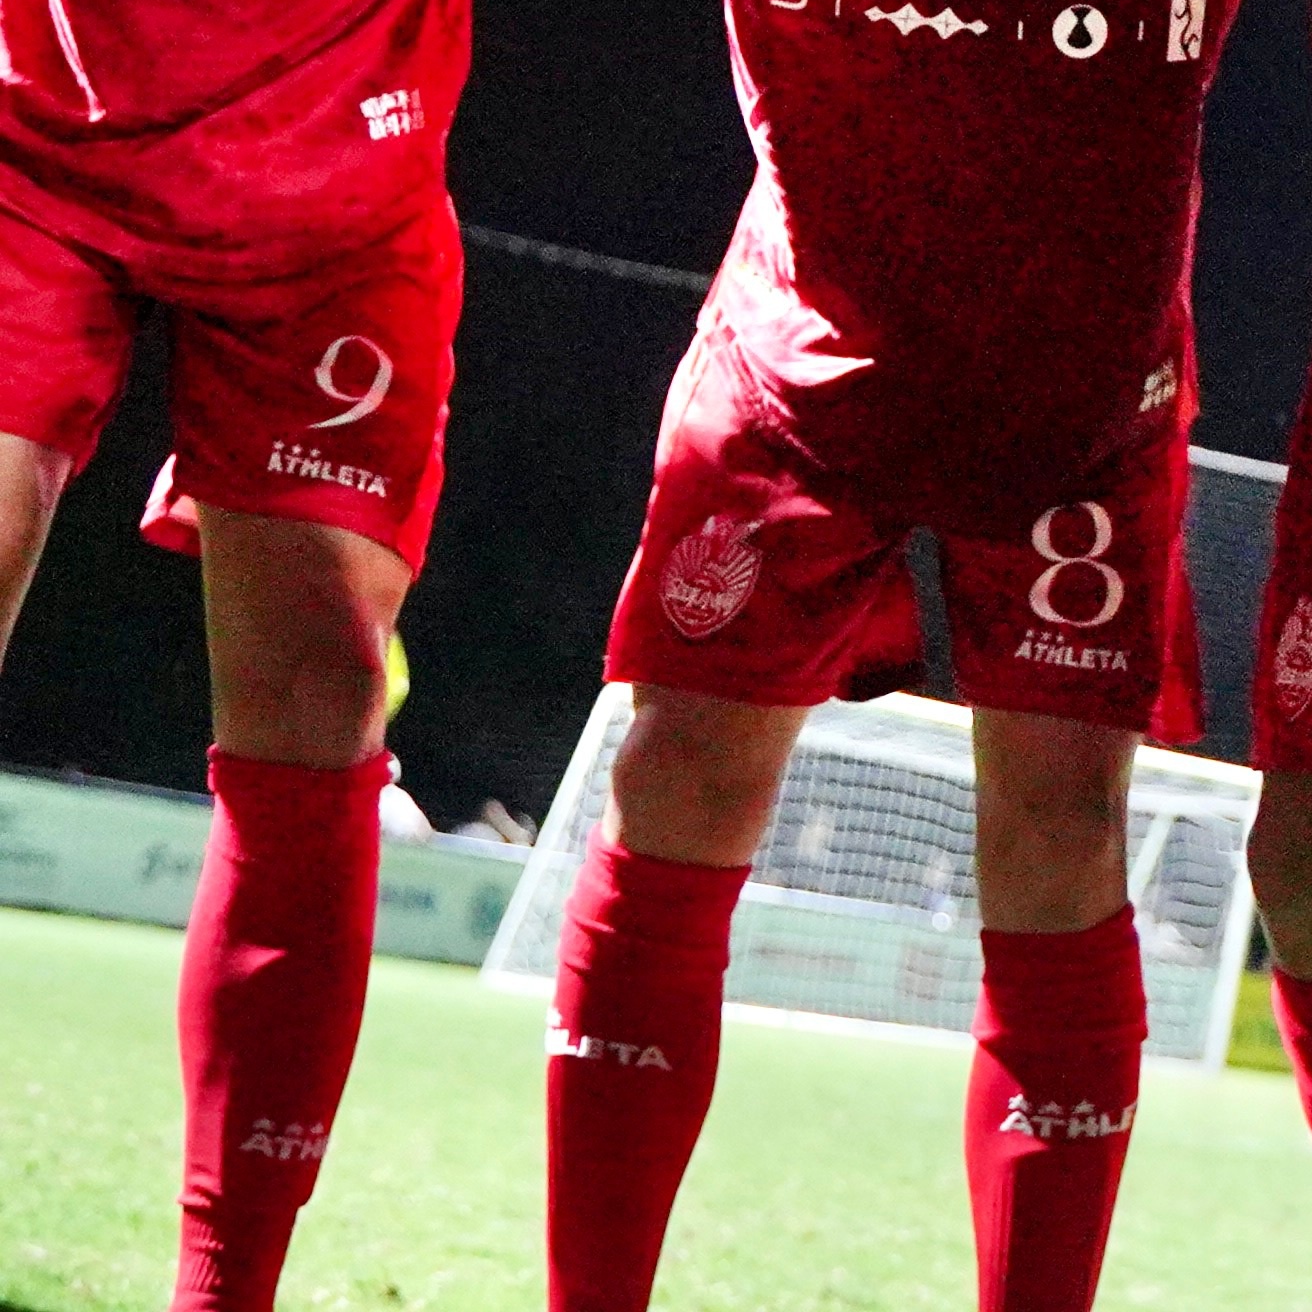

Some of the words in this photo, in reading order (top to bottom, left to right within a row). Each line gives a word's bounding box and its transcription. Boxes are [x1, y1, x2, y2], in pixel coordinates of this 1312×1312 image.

[307, 335, 394, 429] 9
[267, 452, 388, 498] ATHLETA
[1028, 501, 1125, 628] 8
[1014, 639, 1129, 671] ATHLETA
